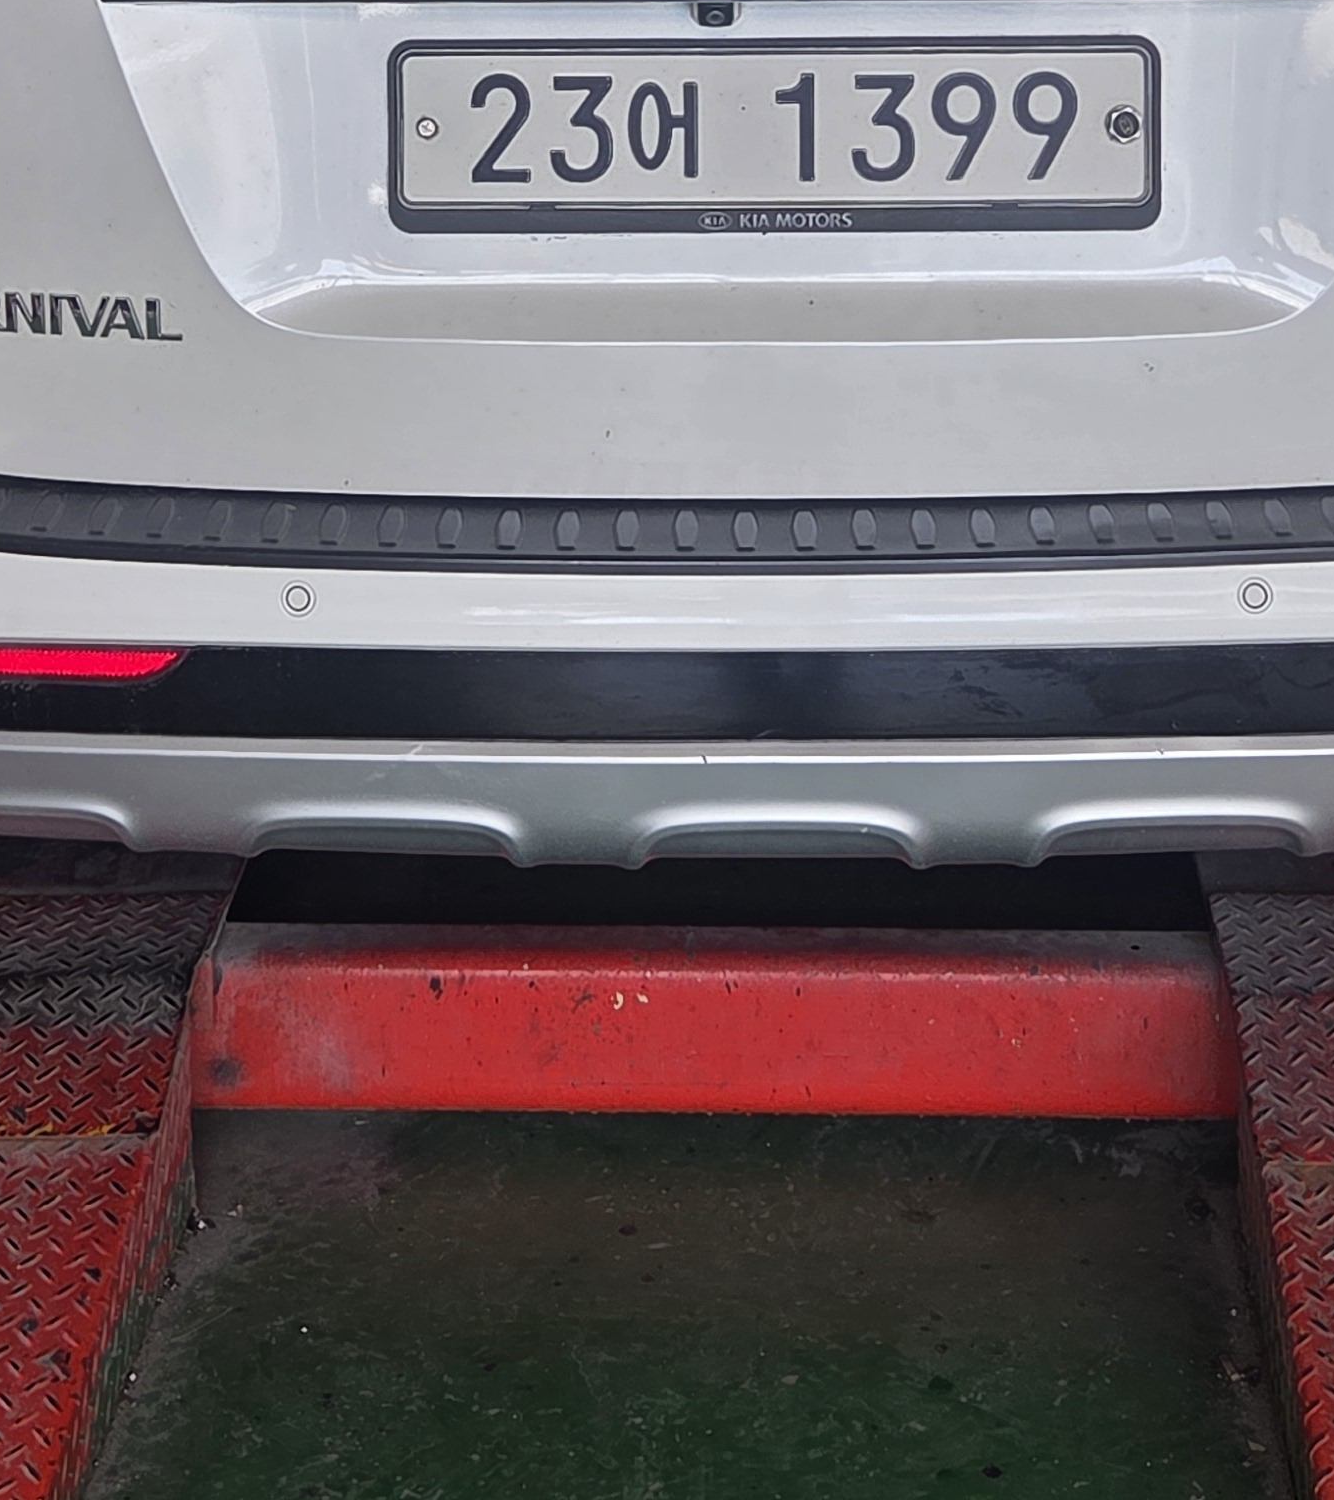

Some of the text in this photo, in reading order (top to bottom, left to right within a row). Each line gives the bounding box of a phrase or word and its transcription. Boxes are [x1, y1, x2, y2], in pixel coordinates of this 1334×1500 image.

[470, 71, 1079, 184] 23어 1399
[739, 213, 770, 229] KIA
[775, 212, 853, 229] MOTORS
